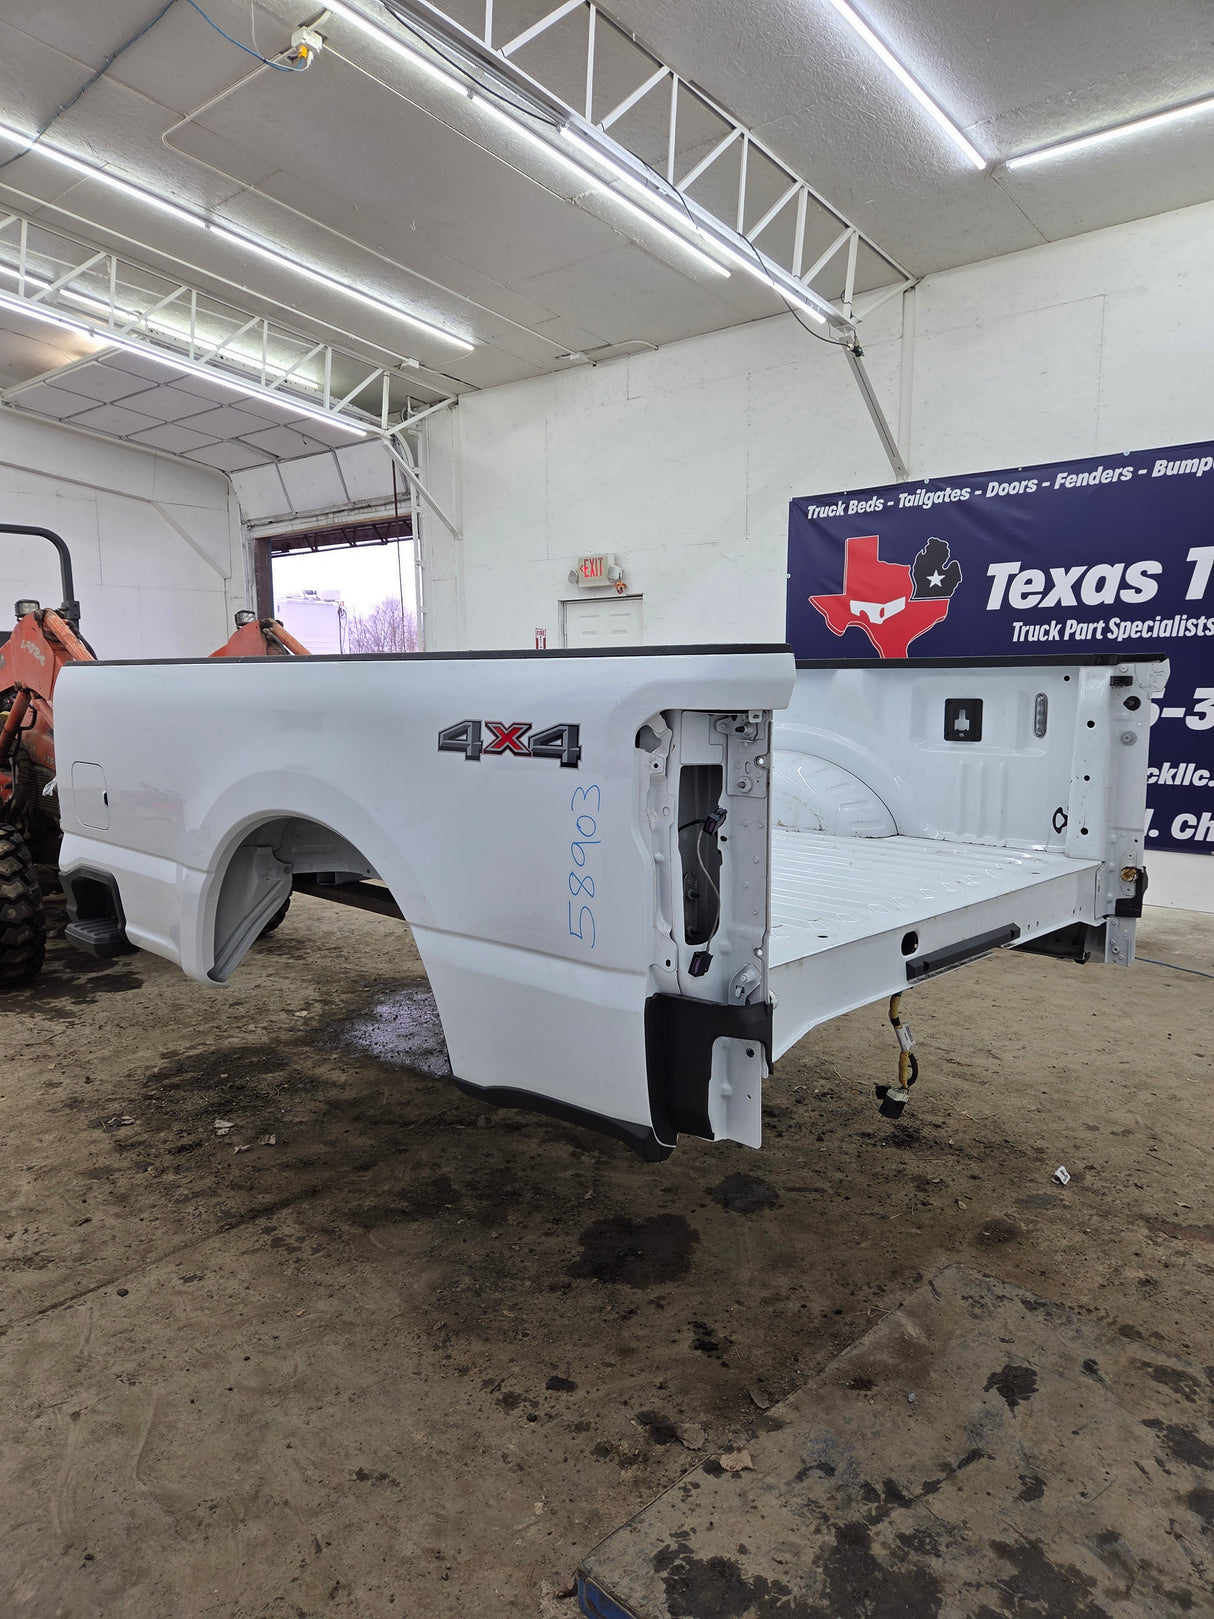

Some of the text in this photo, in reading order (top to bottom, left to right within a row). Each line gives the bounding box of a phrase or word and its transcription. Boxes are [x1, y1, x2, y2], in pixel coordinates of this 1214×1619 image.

[807, 501, 846, 519] Truck
[848, 496, 884, 515] Beds
[899, 487, 971, 509] Tailgates
[986, 479, 1038, 498] Doors
[1054, 465, 1133, 490] Fenders
[1152, 456, 1214, 477] Bump
[583, 557, 603, 578] EXIT
[986, 560, 1163, 611] Texas
[1012, 614, 1214, 642] Truck Part Specialists
[569, 785, 601, 949] 58903
